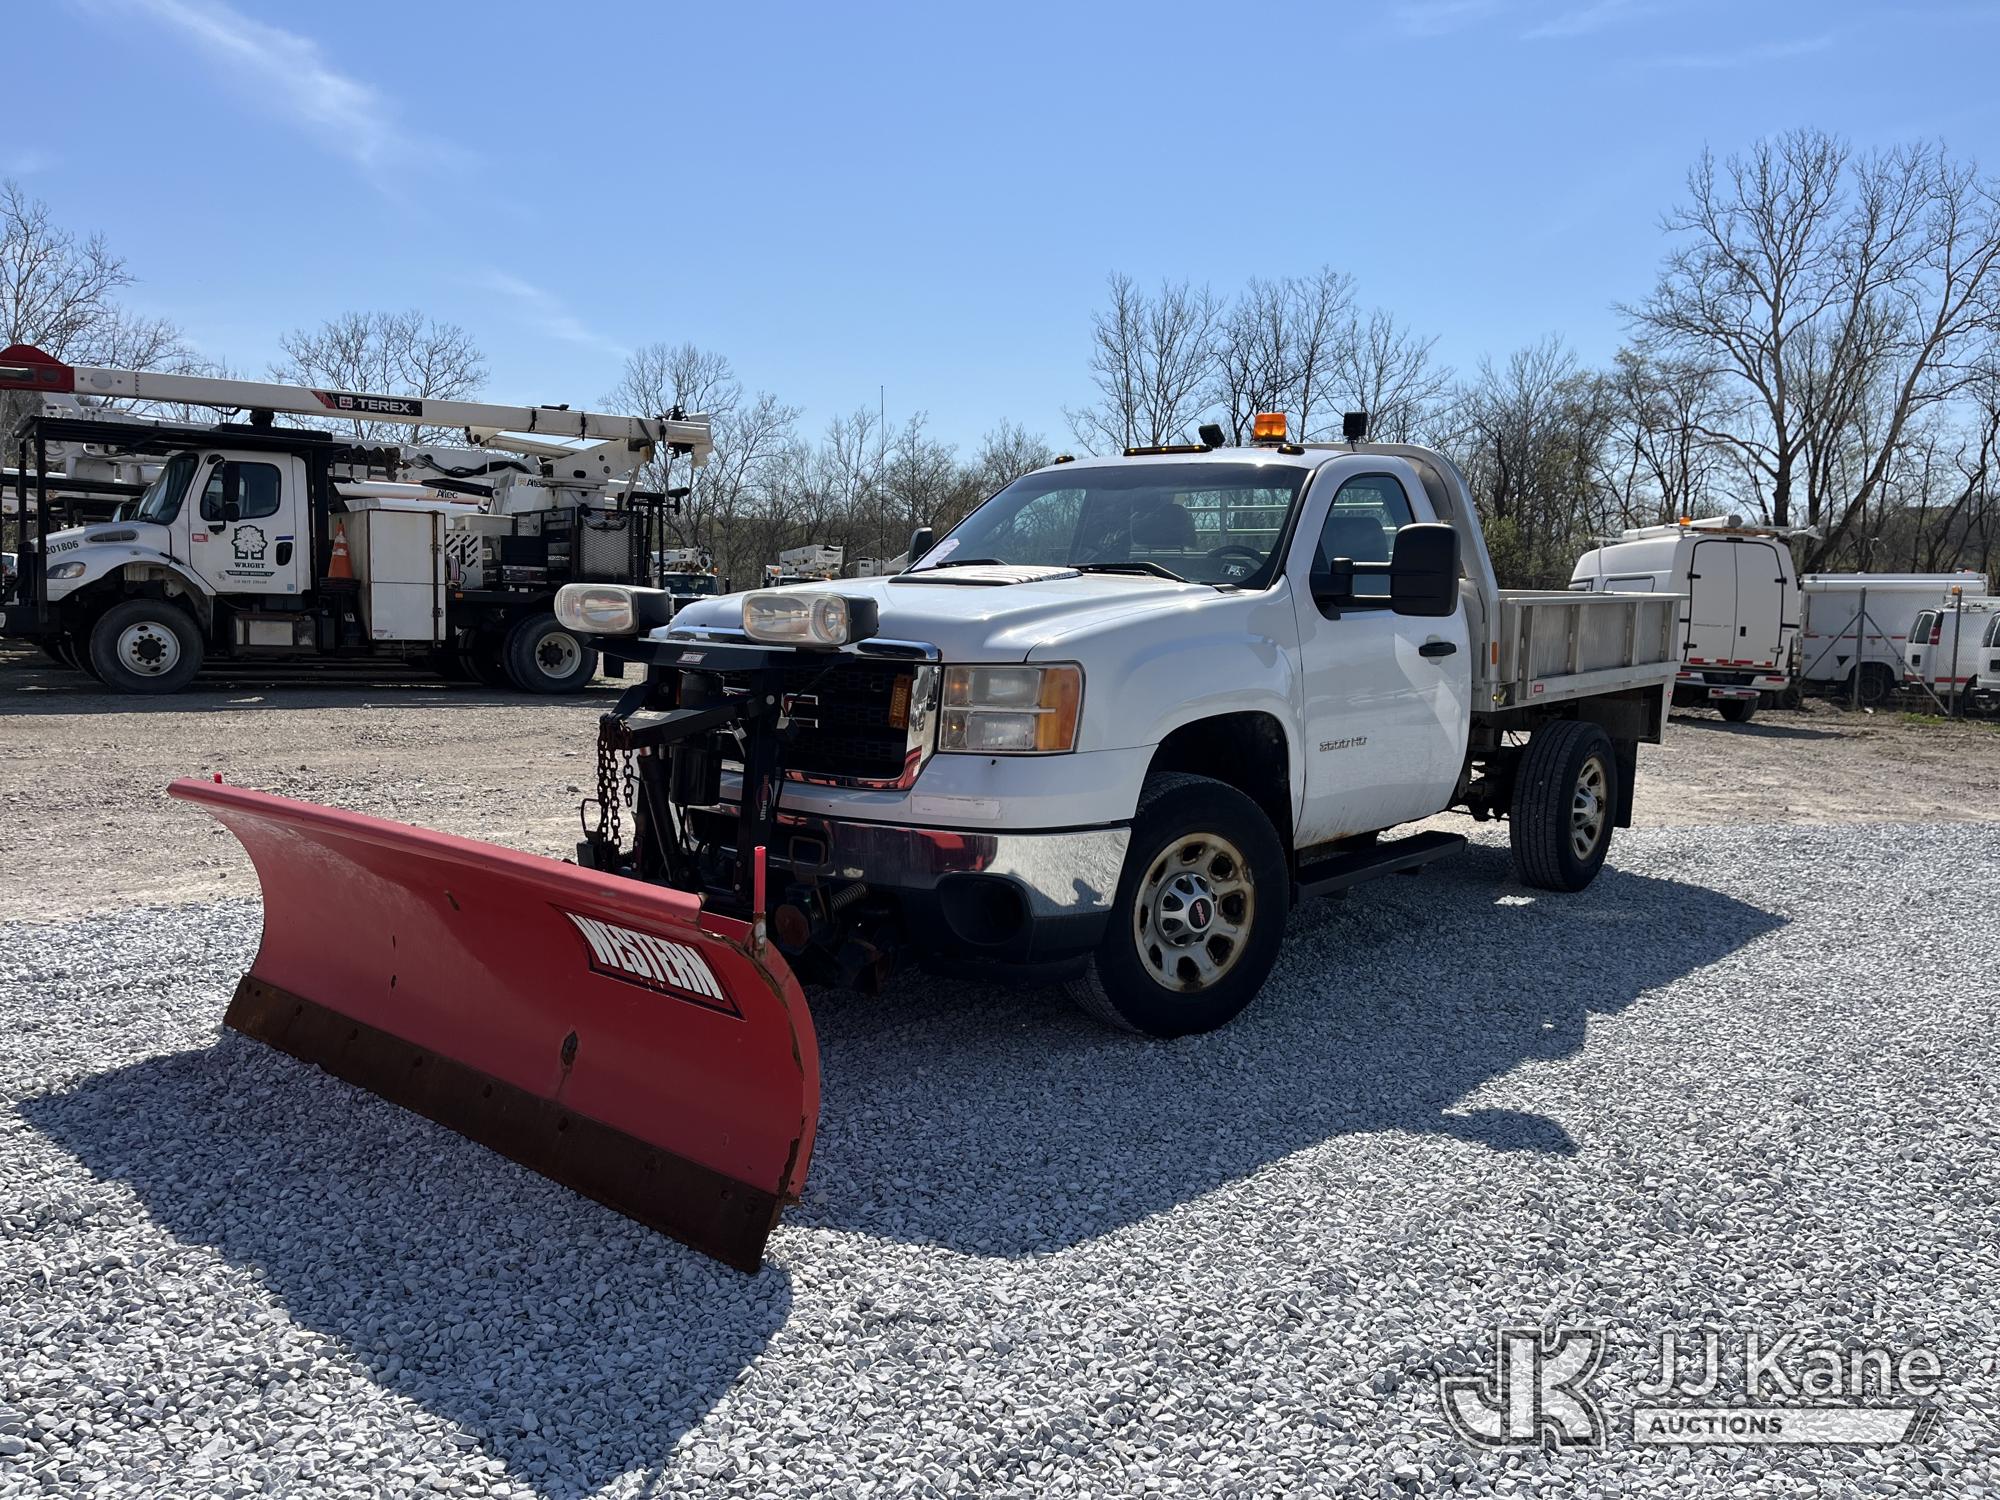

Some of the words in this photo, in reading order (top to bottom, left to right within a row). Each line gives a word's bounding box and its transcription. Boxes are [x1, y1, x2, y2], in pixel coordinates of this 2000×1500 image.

[357, 398, 410, 413] TEREX
[436, 490, 458, 499] Altec
[1195, 901, 1206, 926] GMC
[565, 911, 724, 1001] WESTERN
